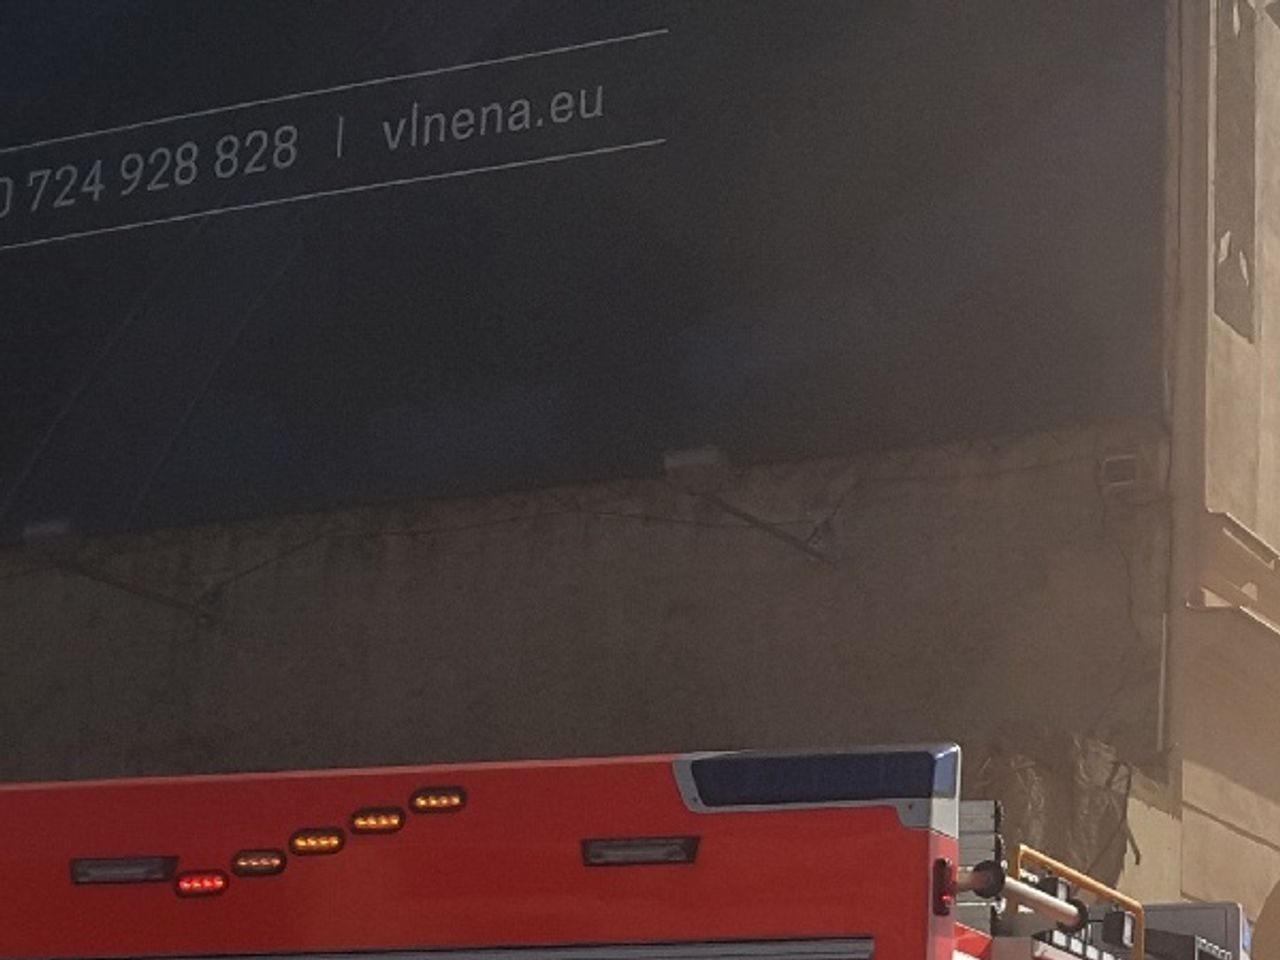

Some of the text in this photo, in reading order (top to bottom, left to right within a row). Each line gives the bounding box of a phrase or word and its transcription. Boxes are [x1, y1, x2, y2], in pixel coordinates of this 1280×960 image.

[26, 159, 106, 213] 724
[119, 140, 200, 197] 928
[213, 124, 299, 179] 828
[382, 85, 605, 150] vlnena.eu
